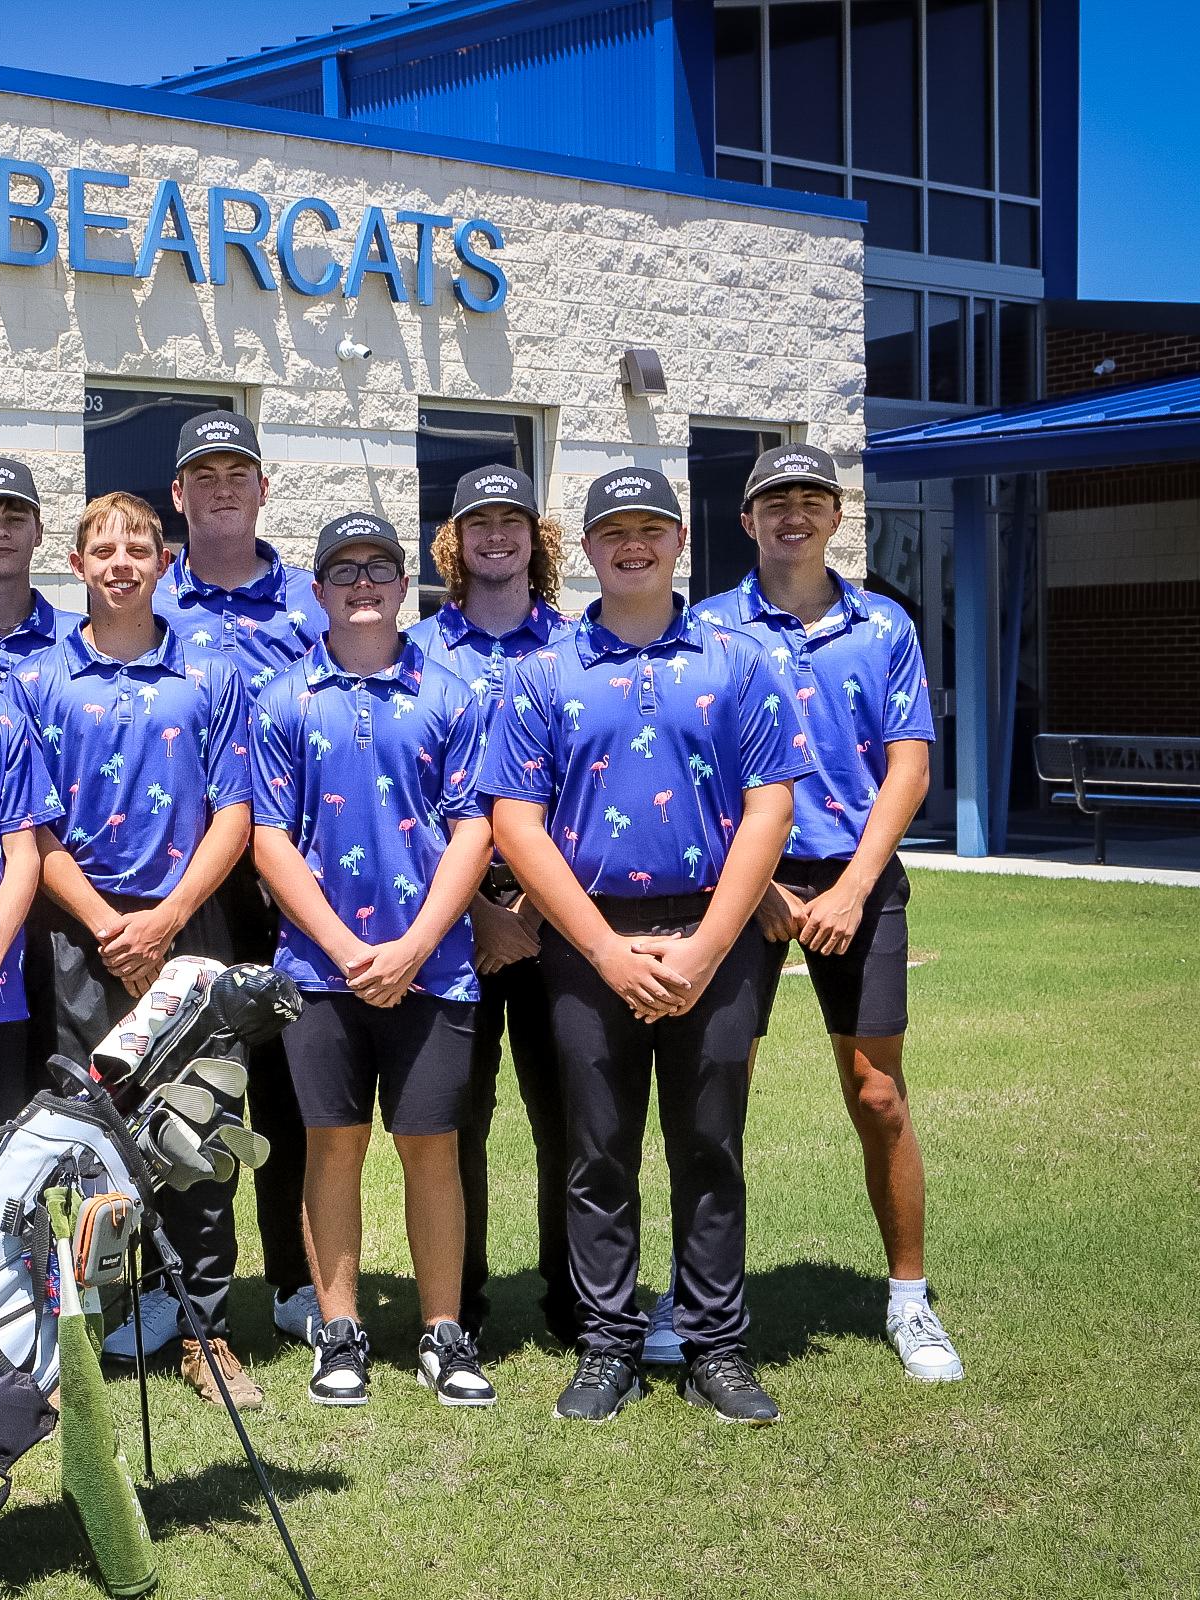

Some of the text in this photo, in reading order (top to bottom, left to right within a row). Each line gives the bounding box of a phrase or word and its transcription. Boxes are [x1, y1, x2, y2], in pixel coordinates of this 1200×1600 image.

[196, 421, 239, 437] BEARCATS
[206, 431, 230, 440] GOLF
[774, 454, 818, 468] BEARCATS
[785, 464, 809, 472] GOLF
[475, 475, 518, 489] BEARCATS
[604, 477, 651, 493] BEARCATS
[485, 485, 508, 494] GOLF
[615, 487, 641, 497] GOLF
[335, 519, 380, 535] BEARCATS
[346, 527, 371, 536] GOLF
